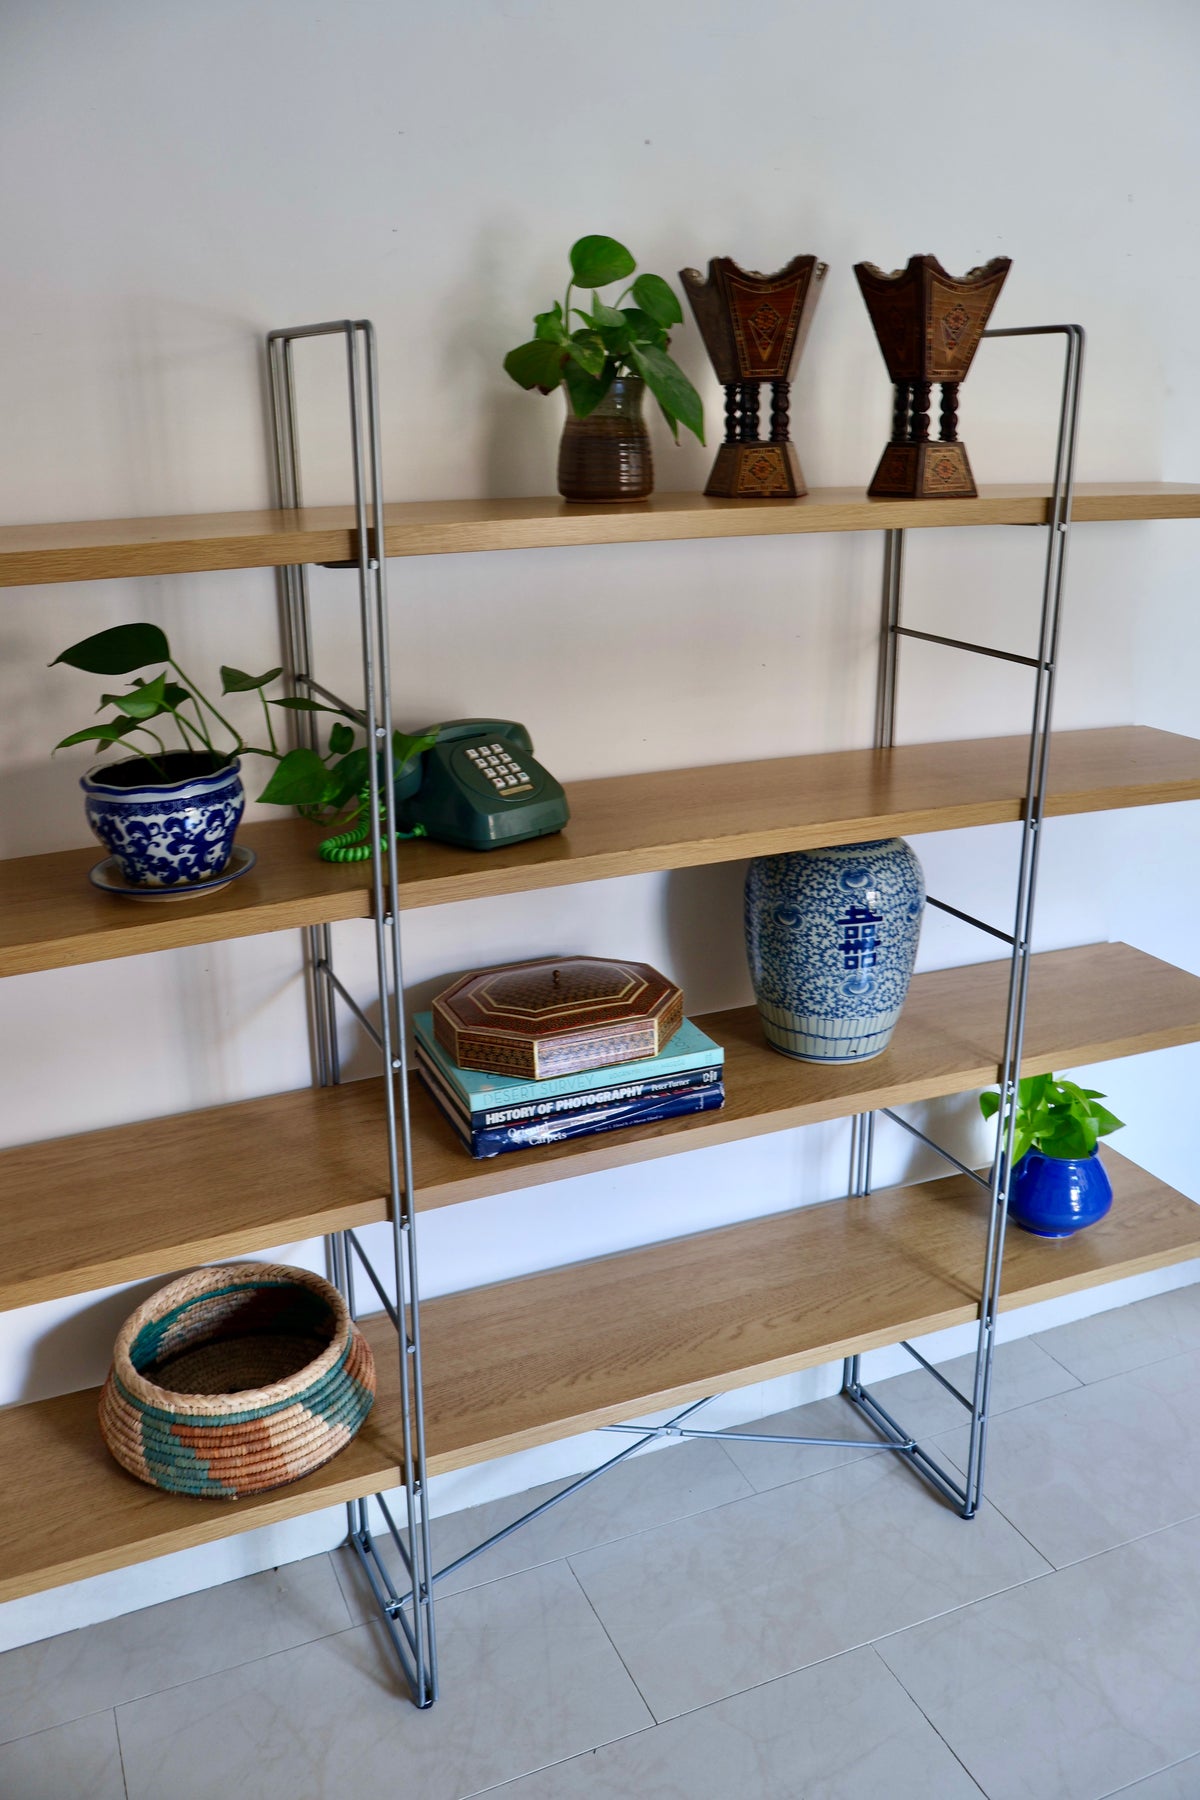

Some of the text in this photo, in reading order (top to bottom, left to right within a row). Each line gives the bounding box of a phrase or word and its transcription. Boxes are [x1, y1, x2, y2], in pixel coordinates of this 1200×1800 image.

[483, 1074, 594, 1105] DESERT SURVEY
[485, 1078, 691, 1125] HISTORY OF PHOTOGRAPHY Peter Turner
[528, 1132, 568, 1147] Carpets
